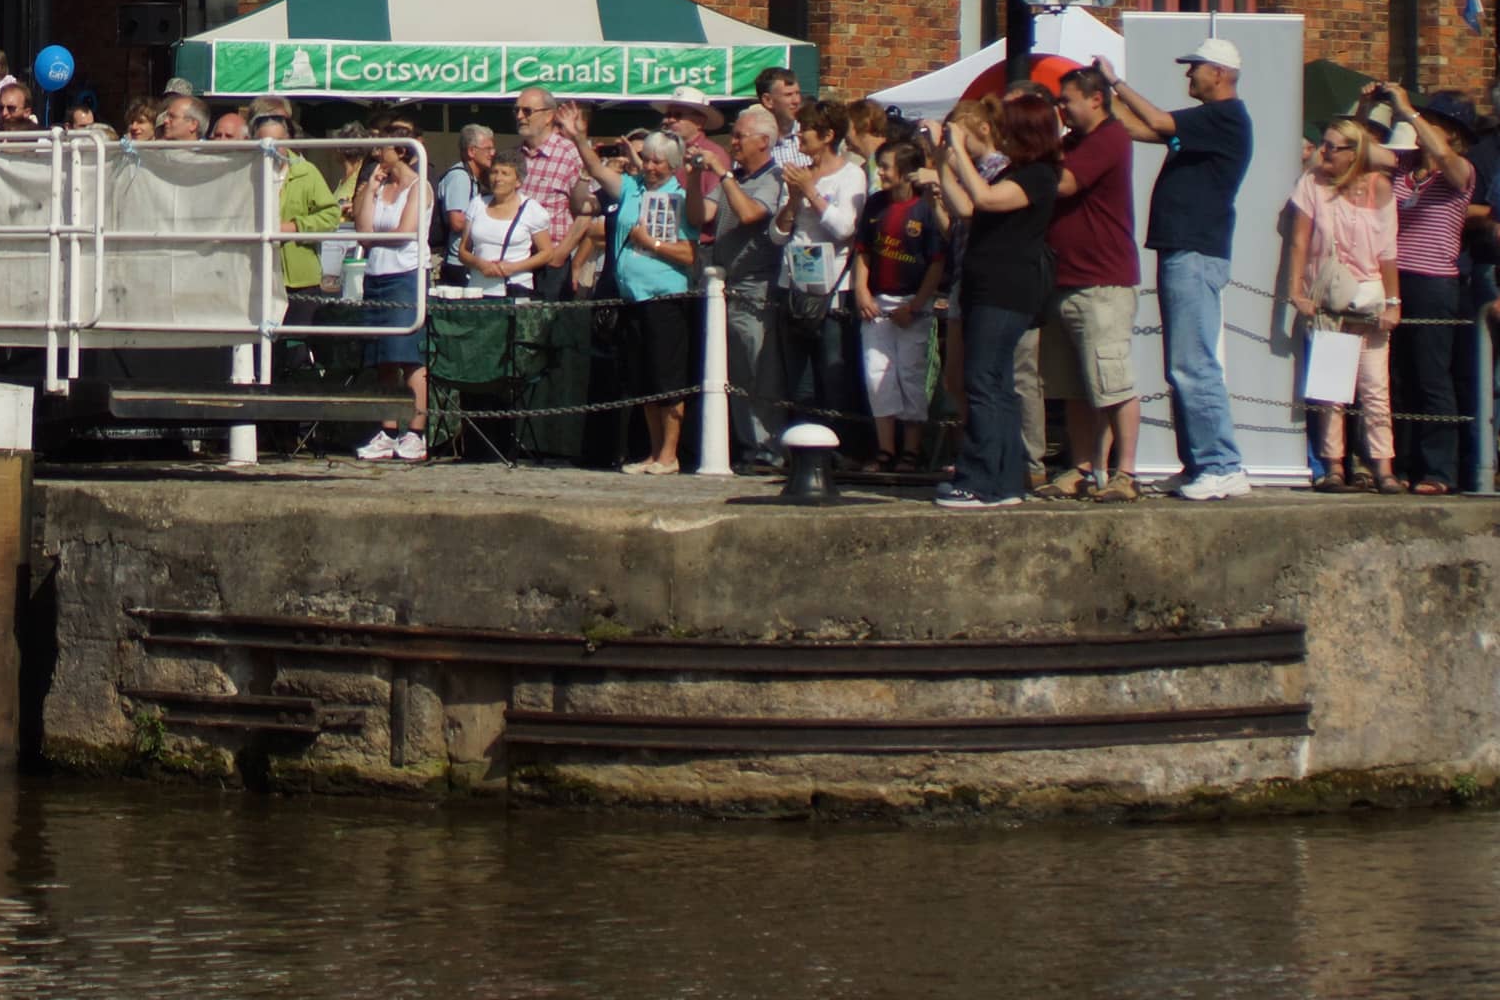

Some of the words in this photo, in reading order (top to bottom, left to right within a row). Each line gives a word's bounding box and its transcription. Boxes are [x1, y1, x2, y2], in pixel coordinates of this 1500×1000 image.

[336, 54, 489, 82] Cotswold
[513, 56, 617, 84] Canals
[633, 57, 716, 85] Trust
